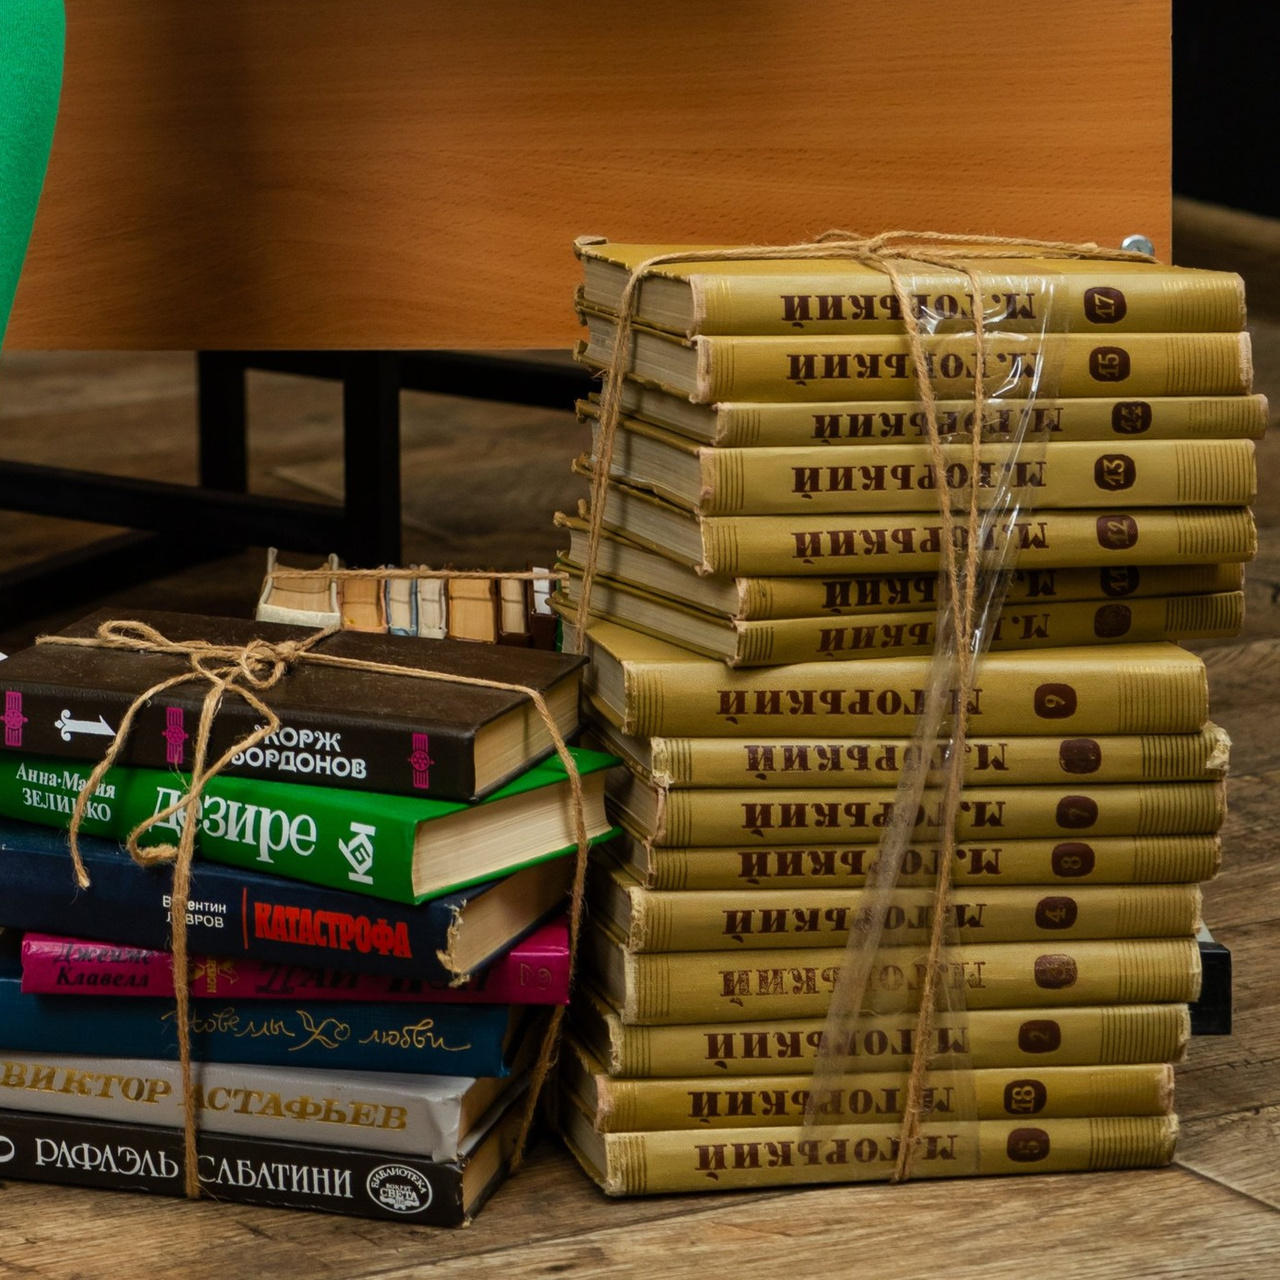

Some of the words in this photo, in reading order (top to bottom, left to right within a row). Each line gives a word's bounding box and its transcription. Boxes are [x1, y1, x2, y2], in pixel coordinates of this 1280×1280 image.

[1094, 293, 1115, 317] 17
[1098, 353, 1119, 376] 15
[1103, 459, 1124, 484] 13
[22, 786, 112, 823] ЗЕЛИКО
[162, 895, 227, 915] Вентин
[1045, 908, 1065, 922] 4
[254, 901, 412, 959] КАТАСТРОФА
[56, 966, 150, 988] Клавелл
[359, 1019, 471, 1051] любви
[178, 1083, 408, 1131] АСТАФЬЕВ
[1011, 1086, 1034, 1112] 18
[35, 1137, 179, 1179] РАФАЭЛЬ
[197, 1155, 354, 1198] САБАТИНИ
[371, 1167, 427, 1194] БИБЛИОТЕКА
[380, 1188, 419, 1201] СВЕТА
